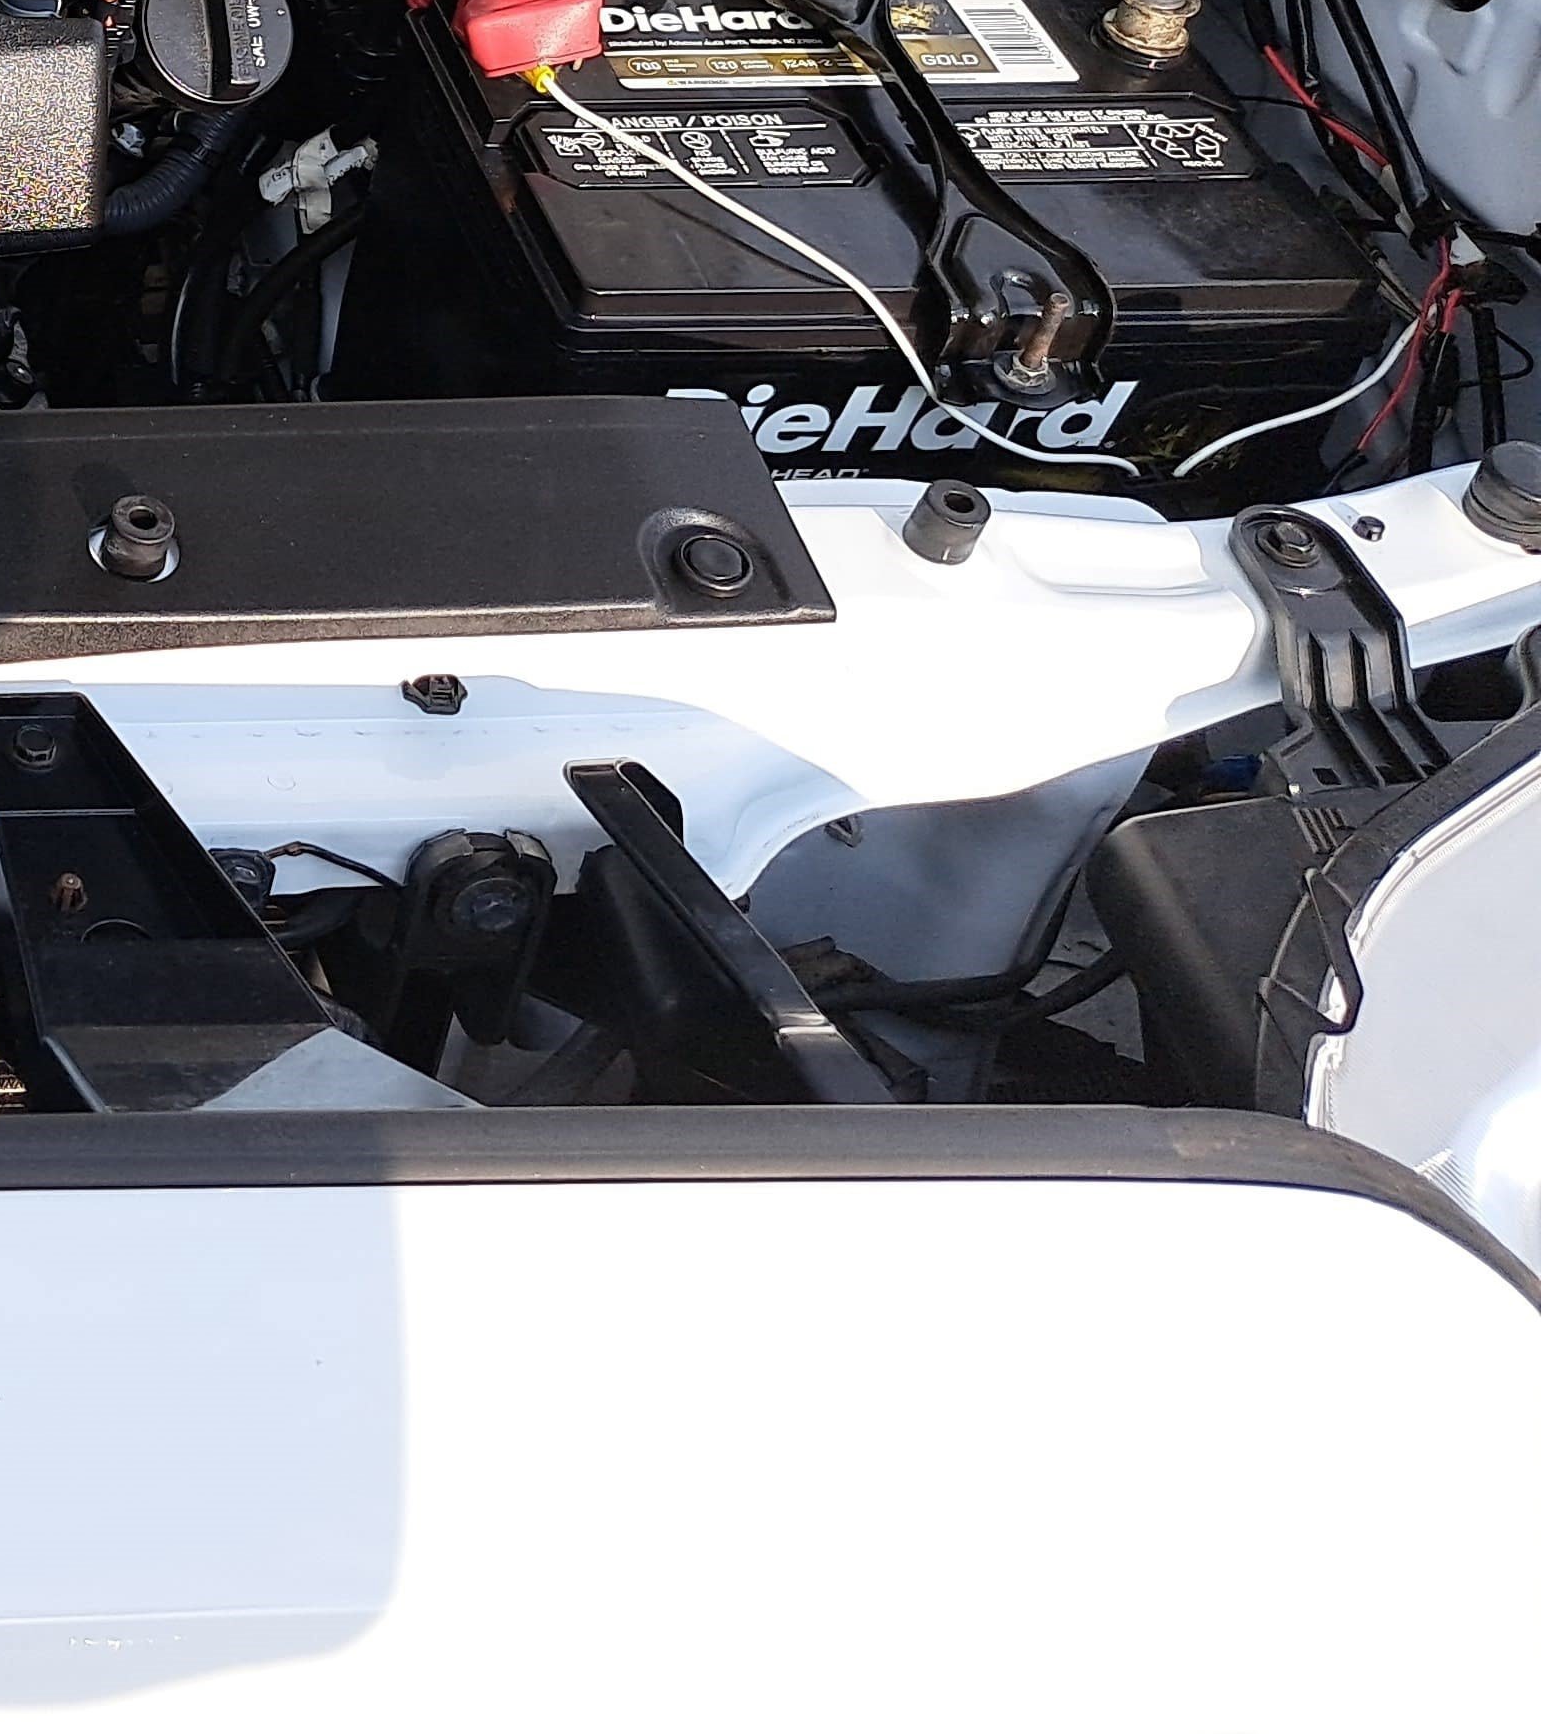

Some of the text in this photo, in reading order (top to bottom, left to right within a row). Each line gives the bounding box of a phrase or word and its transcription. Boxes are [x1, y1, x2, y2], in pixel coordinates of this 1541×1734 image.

[250, 34, 267, 68] SAE
[631, 61, 662, 71] 700
[710, 60, 739, 70] 120
[920, 53, 980, 67] GOLD
[607, 116, 682, 128] ANGER
[700, 114, 784, 127] POISON
[665, 380, 1141, 454] ieHard
